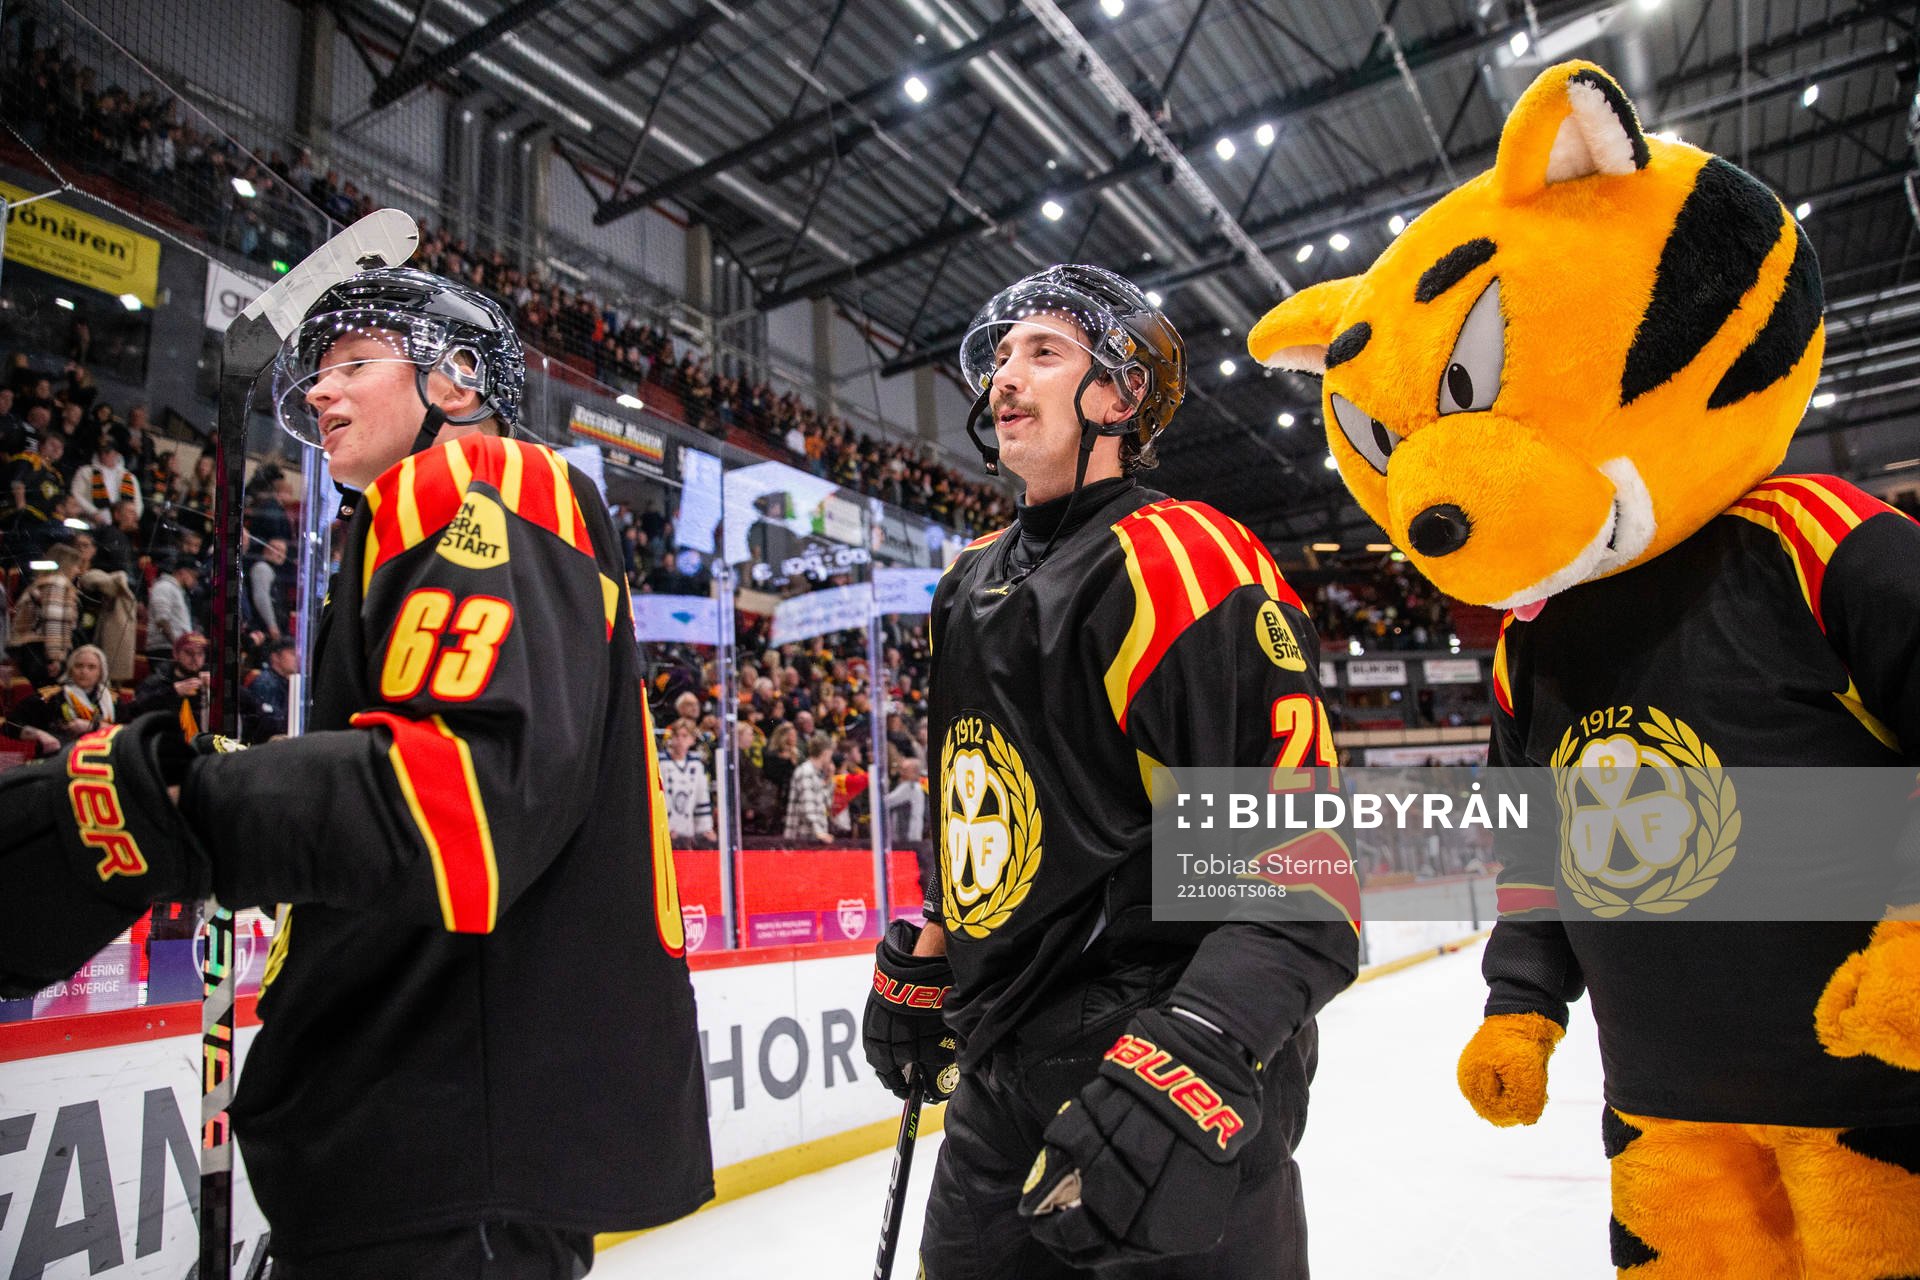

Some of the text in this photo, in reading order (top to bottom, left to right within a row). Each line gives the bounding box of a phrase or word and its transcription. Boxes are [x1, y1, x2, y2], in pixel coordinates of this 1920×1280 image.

[441, 531, 501, 559] START
[380, 587, 514, 702] 63
[1268, 627, 1292, 644] BRA
[954, 717, 984, 746] 1912
[1580, 705, 1634, 738] 1912
[1271, 693, 1341, 793] 24
[965, 769, 976, 798] B
[1598, 754, 1619, 784] B
[37, 984, 69, 999] HELA
[71, 981, 120, 996] SVERIGE
